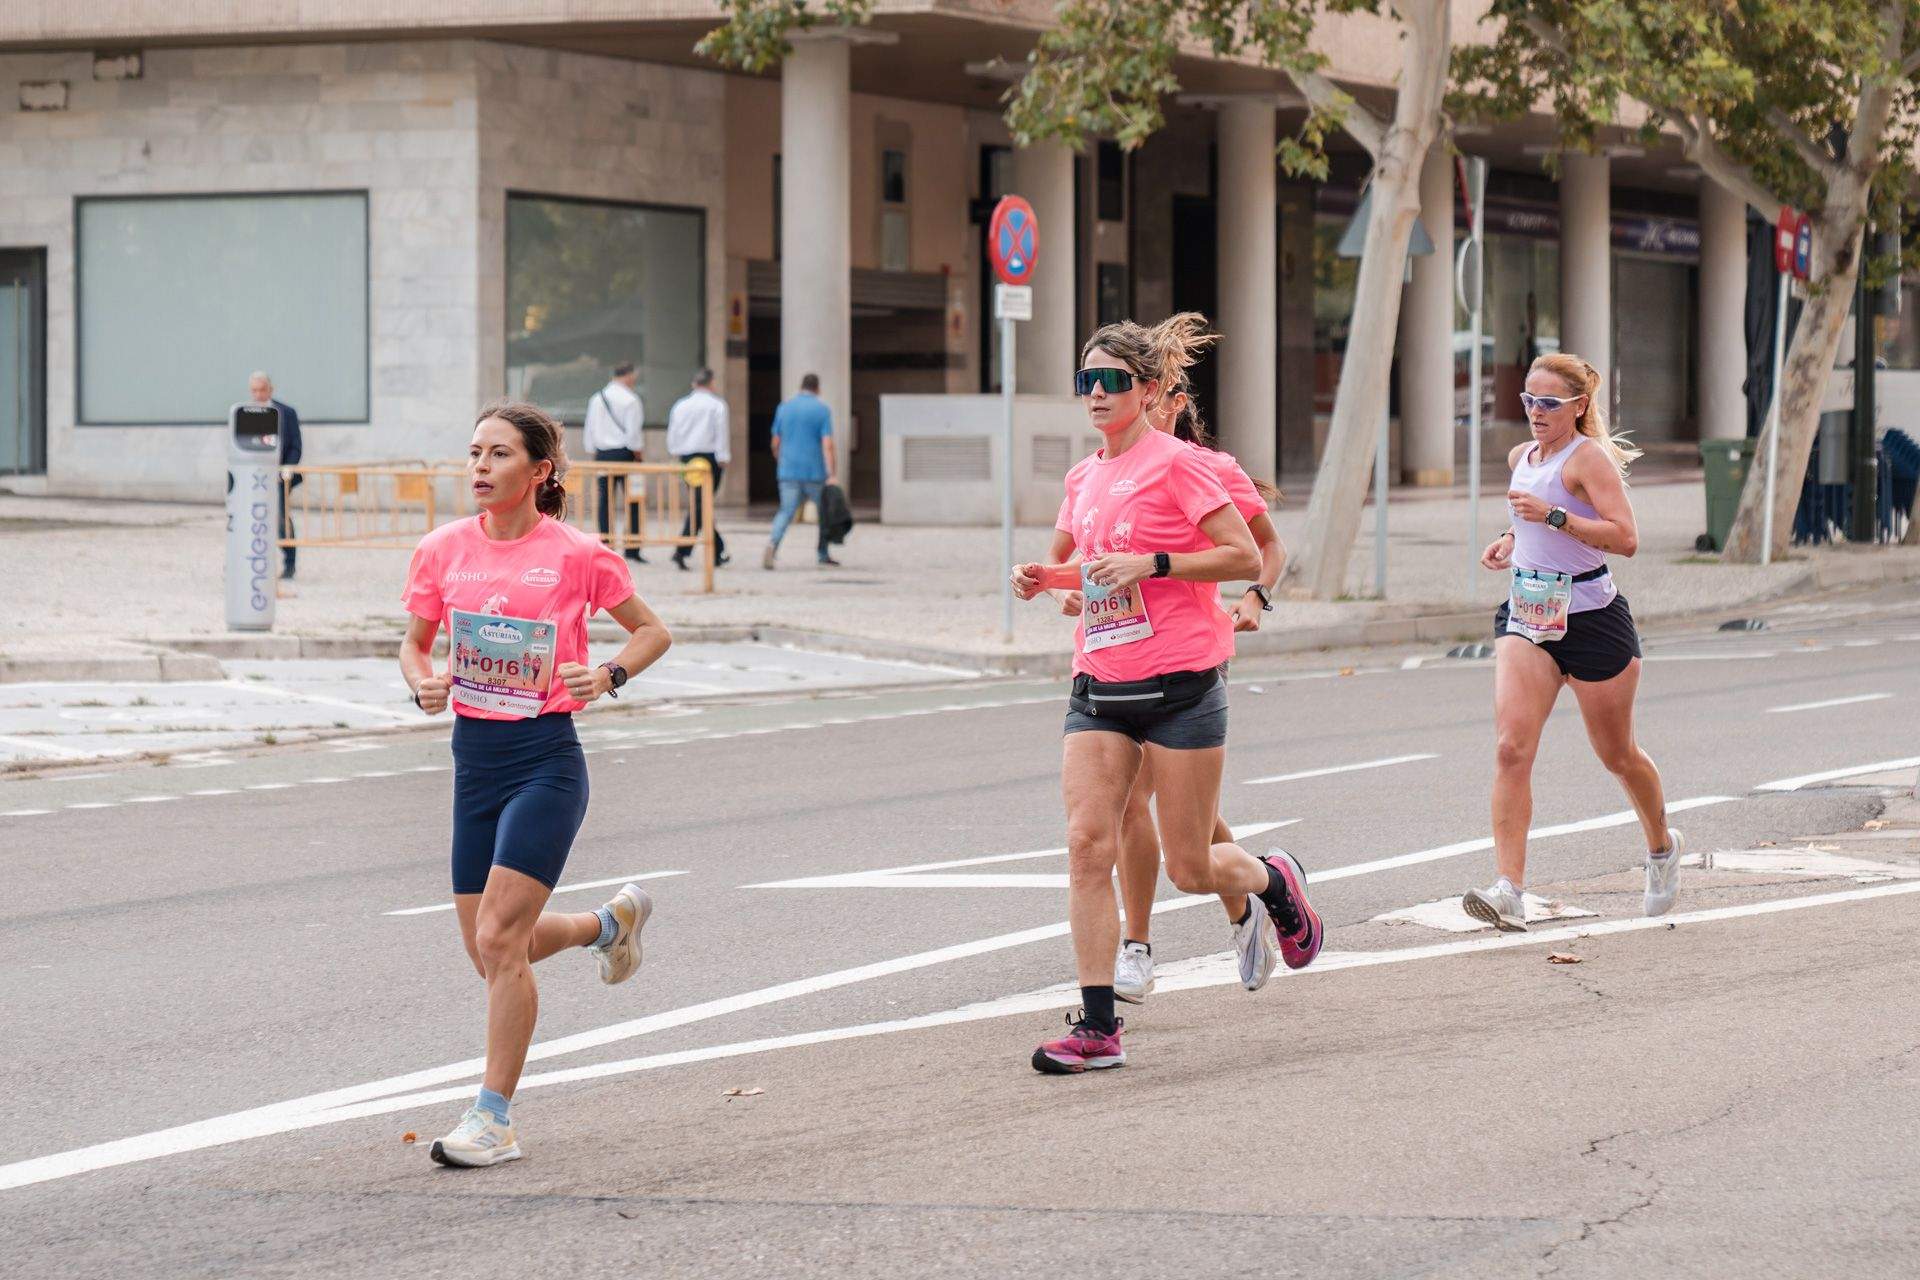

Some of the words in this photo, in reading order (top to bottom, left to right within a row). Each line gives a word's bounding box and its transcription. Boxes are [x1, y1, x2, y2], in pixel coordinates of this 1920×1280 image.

[246, 503, 268, 611] endesa
[1090, 596, 1118, 615] 016
[1523, 602, 1544, 616] 016
[479, 627, 520, 641] ASTURIANA
[480, 656, 519, 676] 016
[460, 690, 487, 703] OYSHO
[506, 701, 537, 712] Santander
